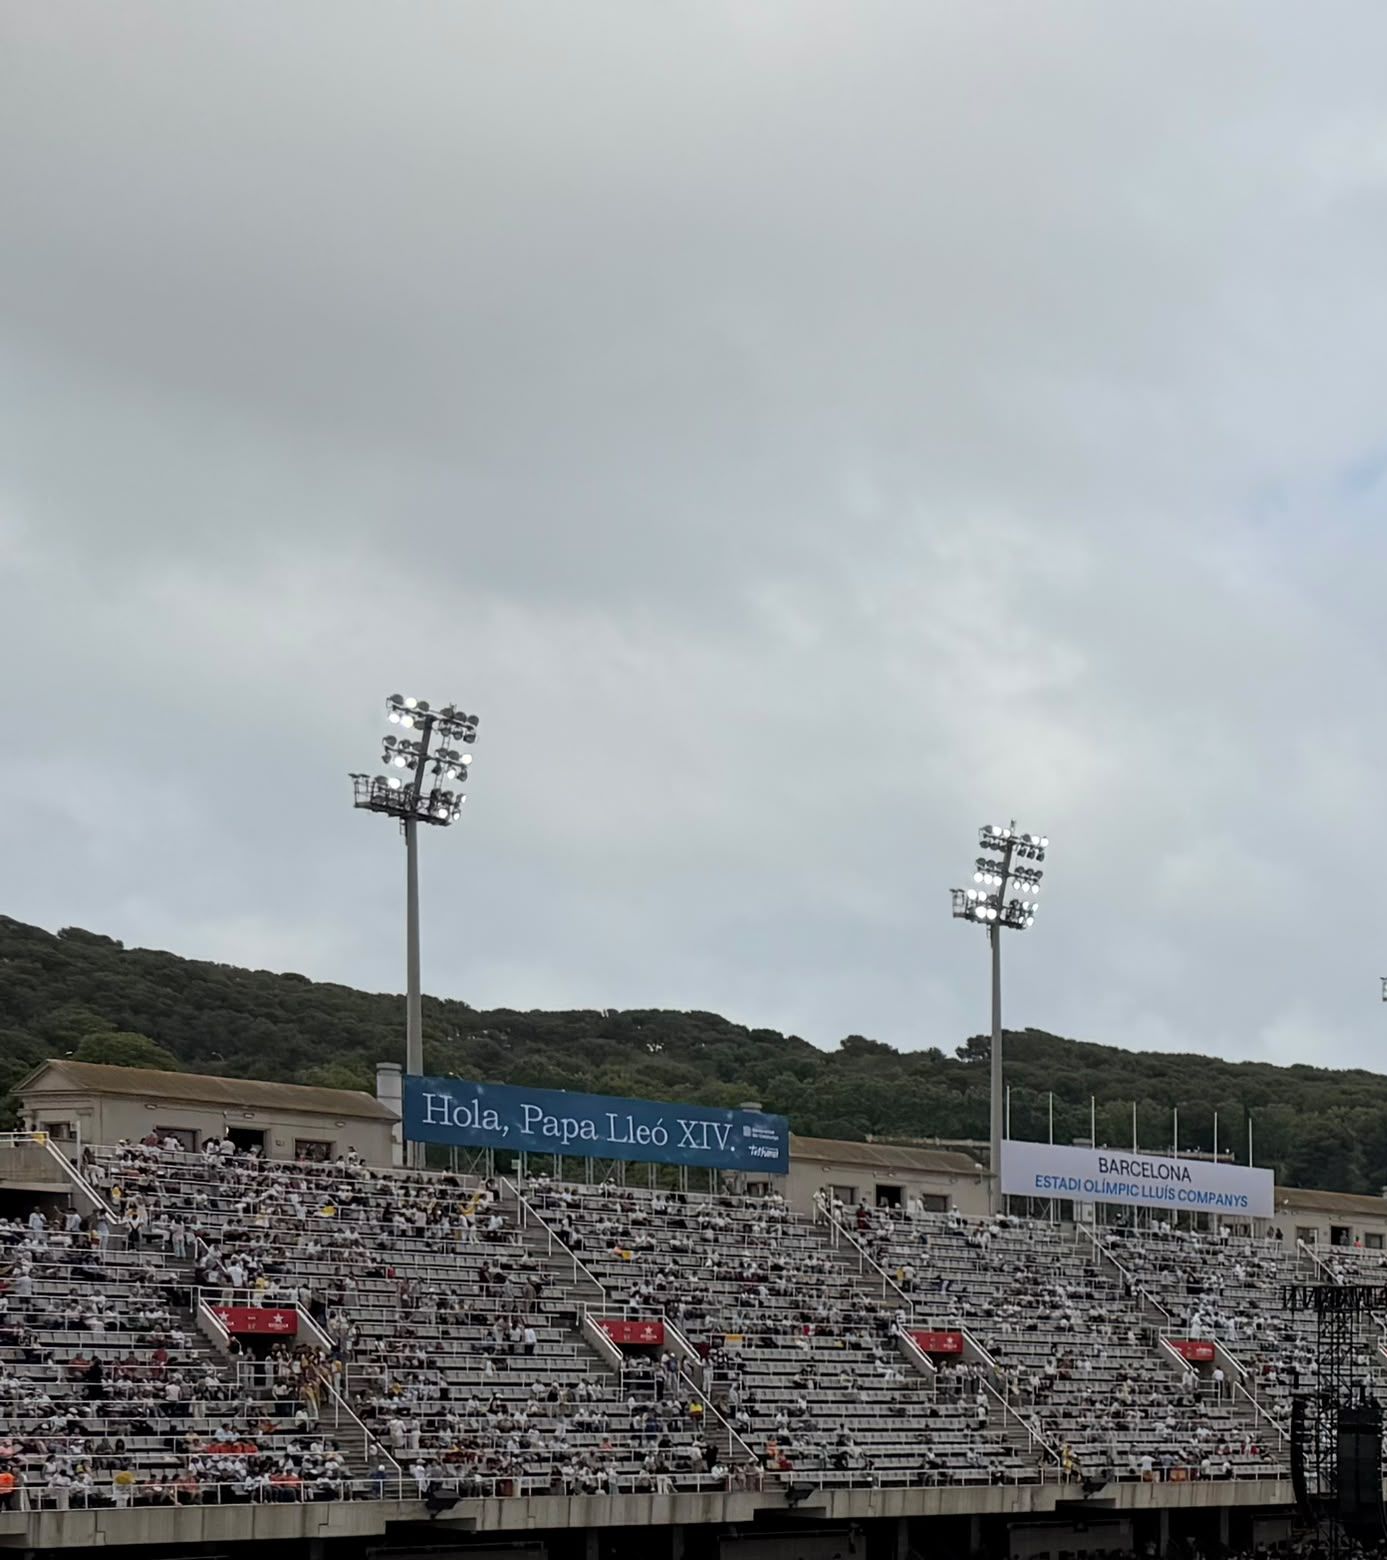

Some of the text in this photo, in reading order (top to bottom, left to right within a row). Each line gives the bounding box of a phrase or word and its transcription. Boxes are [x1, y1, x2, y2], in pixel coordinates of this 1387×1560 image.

[422, 1092, 735, 1152] Hola, Papa Lleó XIV.
[1099, 1157, 1192, 1183] BARCELONA
[1035, 1174, 1248, 1208] ESTADI OLÍMPIC LLUÍS COMPANYS
